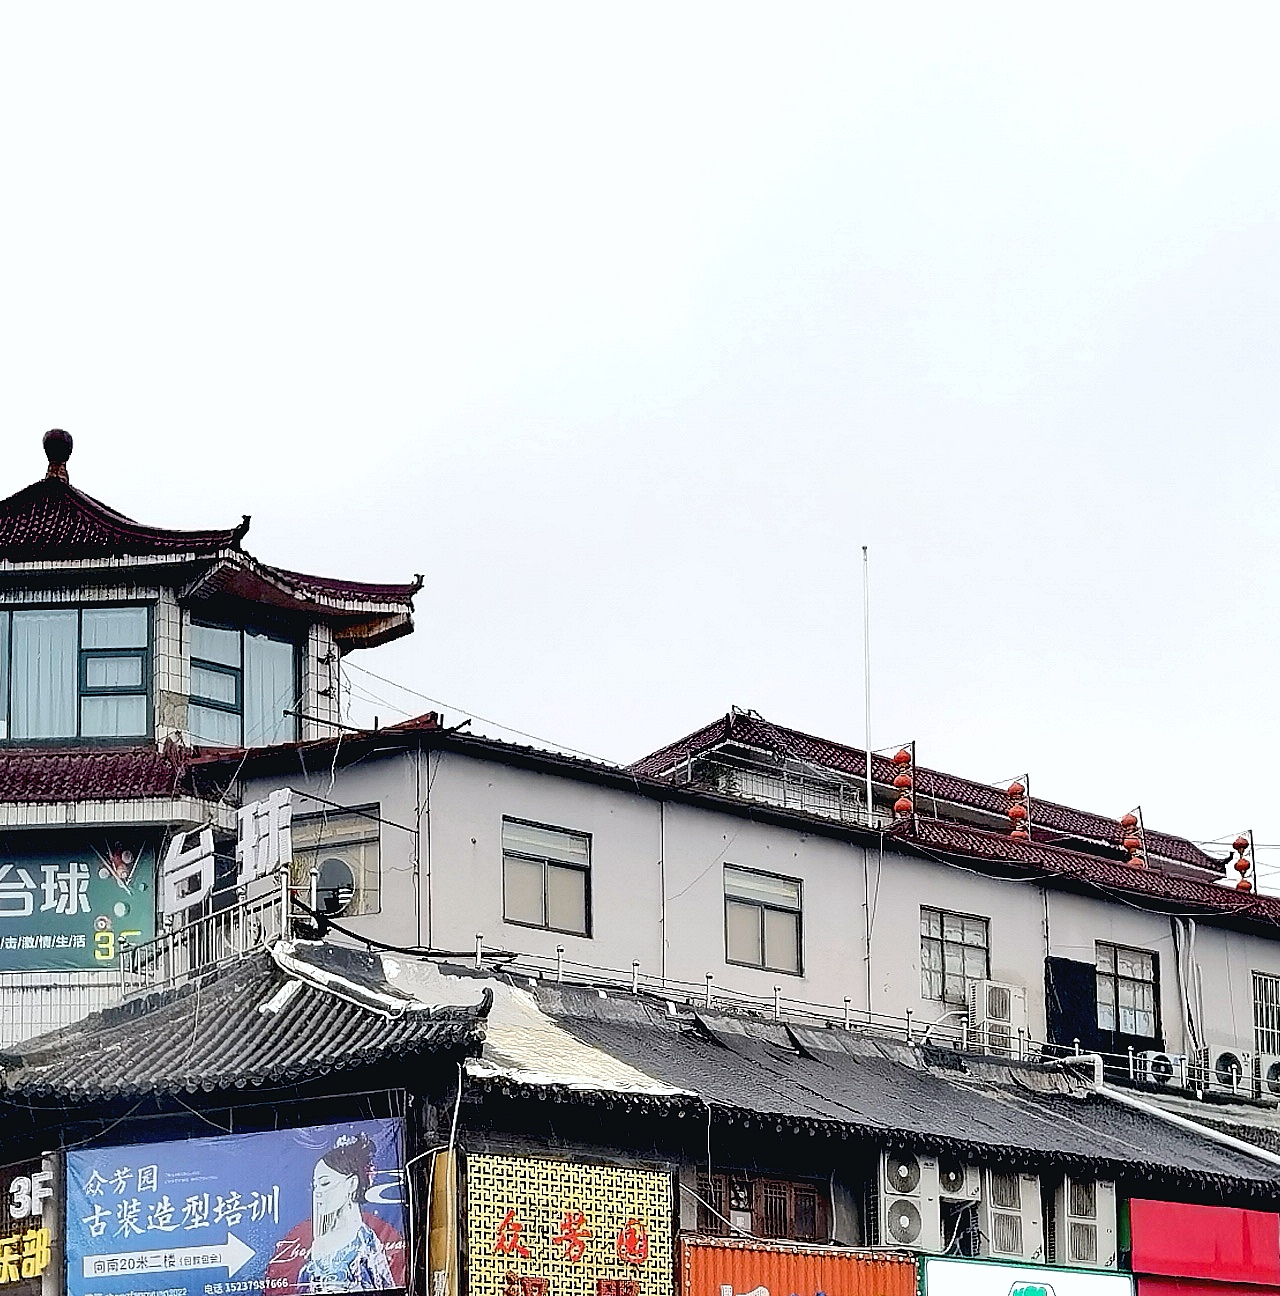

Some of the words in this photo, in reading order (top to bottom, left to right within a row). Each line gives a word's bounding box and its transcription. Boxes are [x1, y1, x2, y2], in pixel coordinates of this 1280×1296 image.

[159, 788, 294, 914] 台球
[10, 1171, 54, 1219] 3F
[84, 1165, 159, 1197] 众芳园
[82, 1184, 280, 1239] 古装造型培训
[493, 1209, 648, 1264] 众芳园
[93, 1254, 177, 1275] 向南20米二楼
[204, 1281, 223, 1295] 电话
